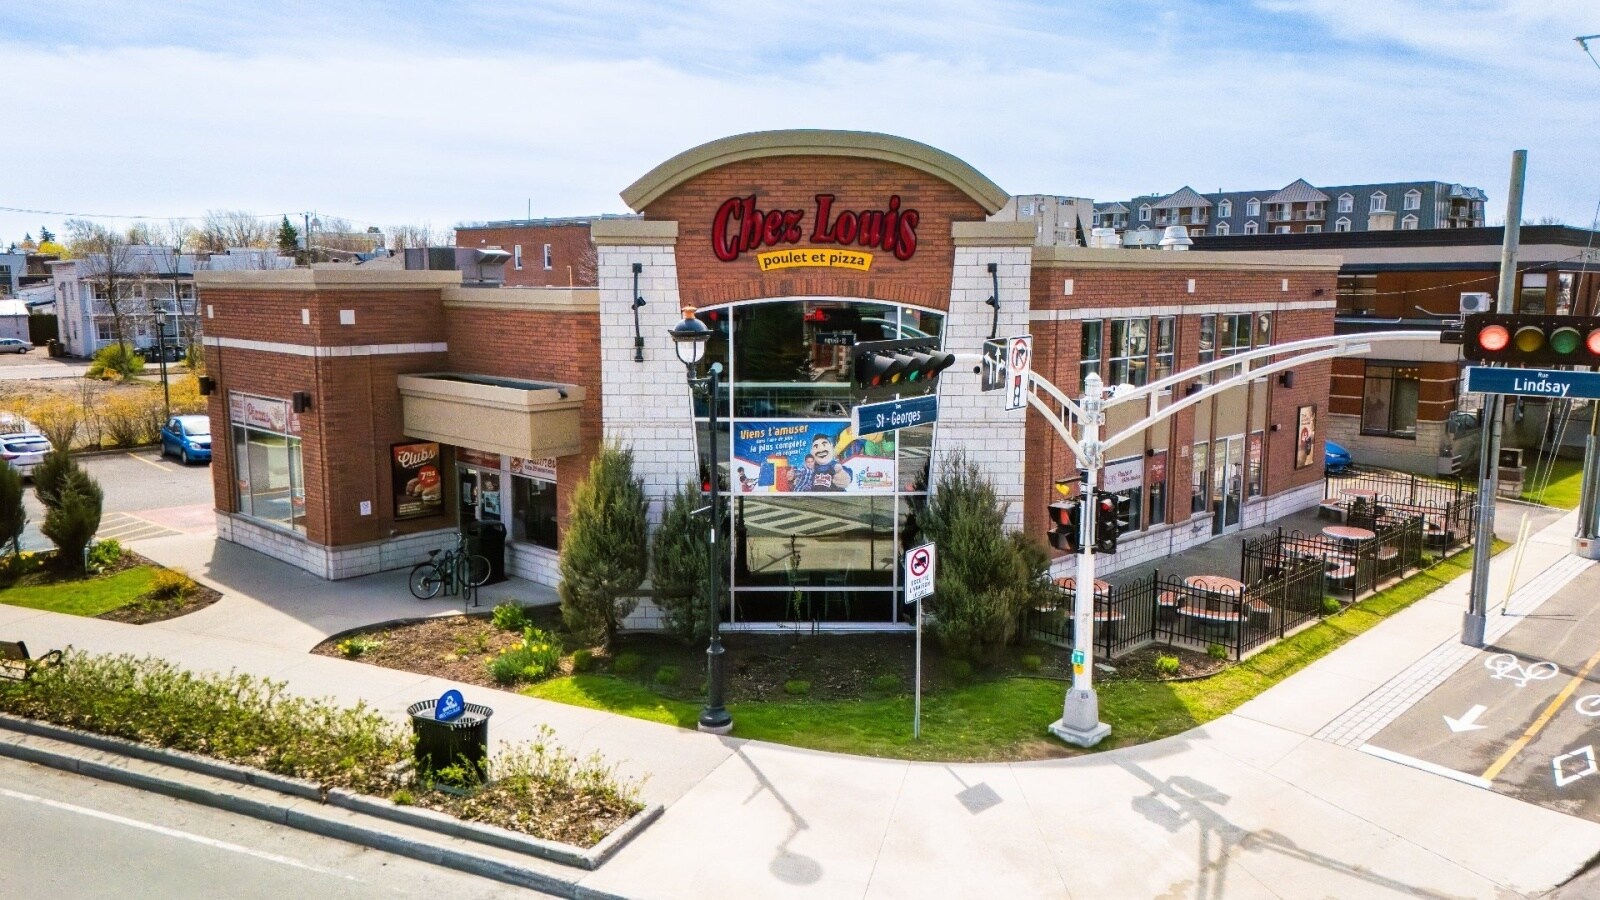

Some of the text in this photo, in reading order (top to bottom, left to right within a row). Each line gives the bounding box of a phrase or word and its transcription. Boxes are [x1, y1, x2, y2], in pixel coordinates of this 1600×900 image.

[712, 193, 920, 262] Chez Louis
[763, 252, 865, 268] poulet et pizza
[1514, 378, 1571, 397] Lindsay
[740, 425, 809, 440] Viens t'amuser
[398, 447, 437, 468] Clubs
[750, 445, 757, 453] la
[759, 444, 773, 454] plus
